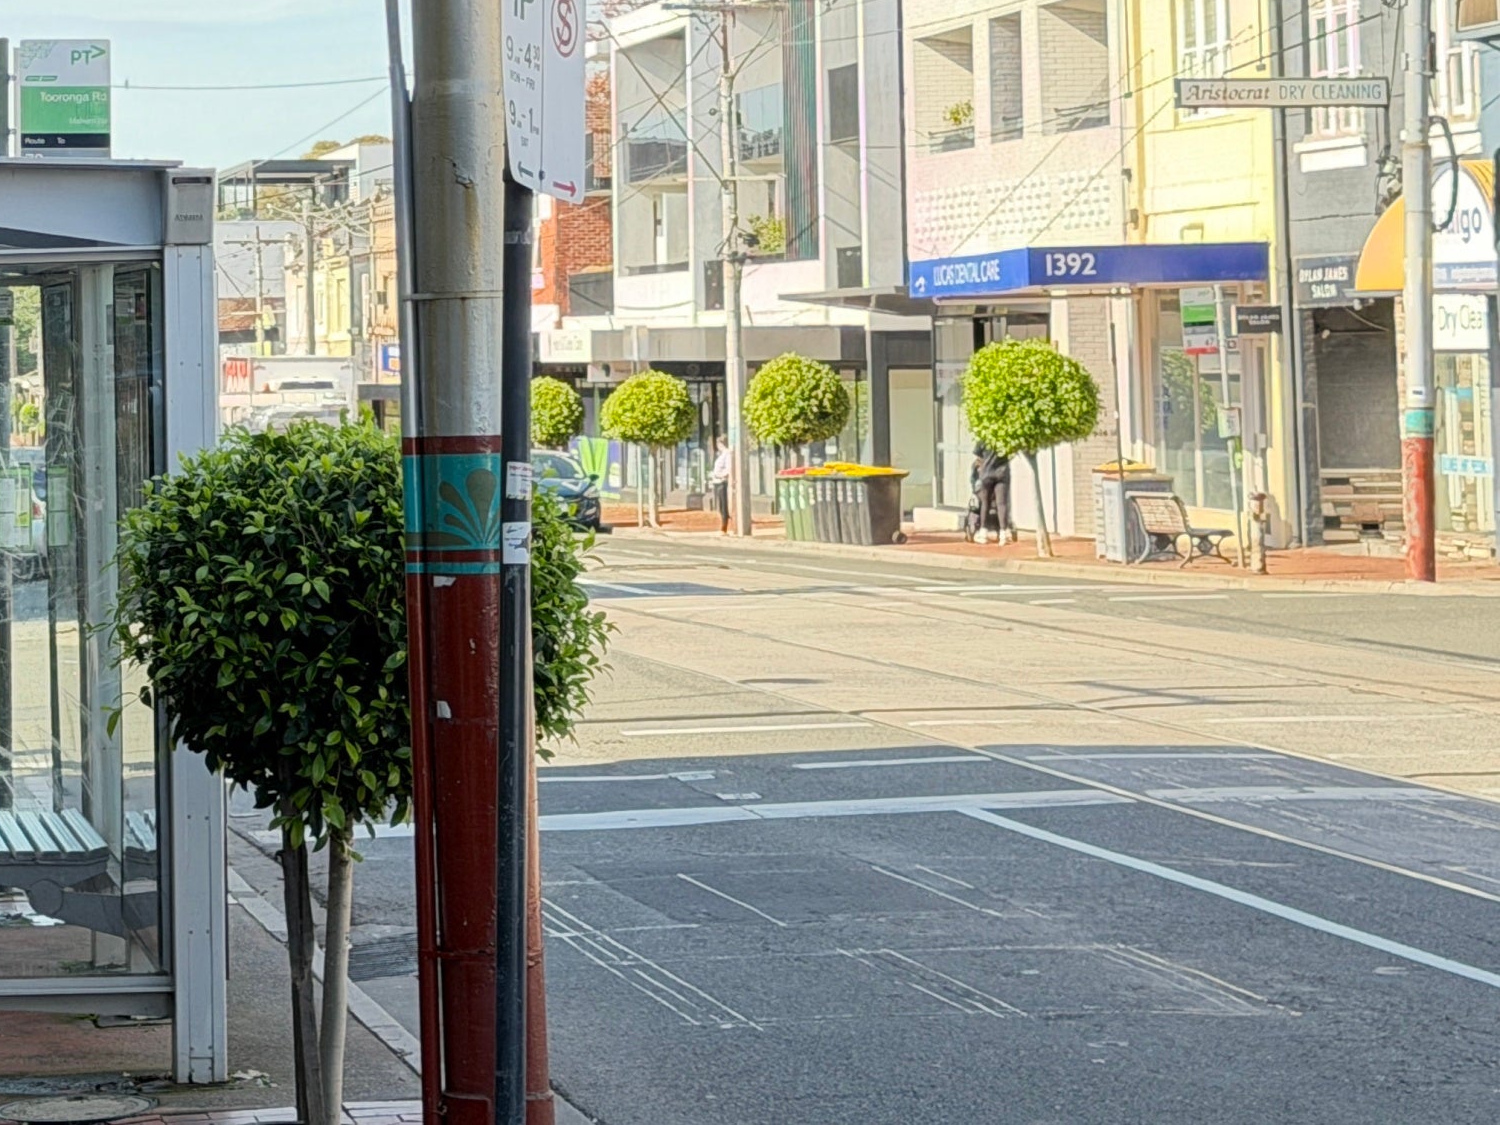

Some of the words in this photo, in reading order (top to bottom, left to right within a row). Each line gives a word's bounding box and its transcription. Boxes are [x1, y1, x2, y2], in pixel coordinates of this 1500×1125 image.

[40, 91, 89, 104] Tooronga
[92, 91, 107, 102] Rd
[1185, 84, 1271, 101] Aristocrat
[1279, 85, 1306, 100] DRY
[1312, 83, 1381, 100] CLEANING
[56, 137, 66, 145] To
[933, 264, 954, 287] LUCAS
[980, 258, 1000, 282] CARE
[1046, 252, 1097, 276] 1392
[1438, 305, 1457, 338] Dry
